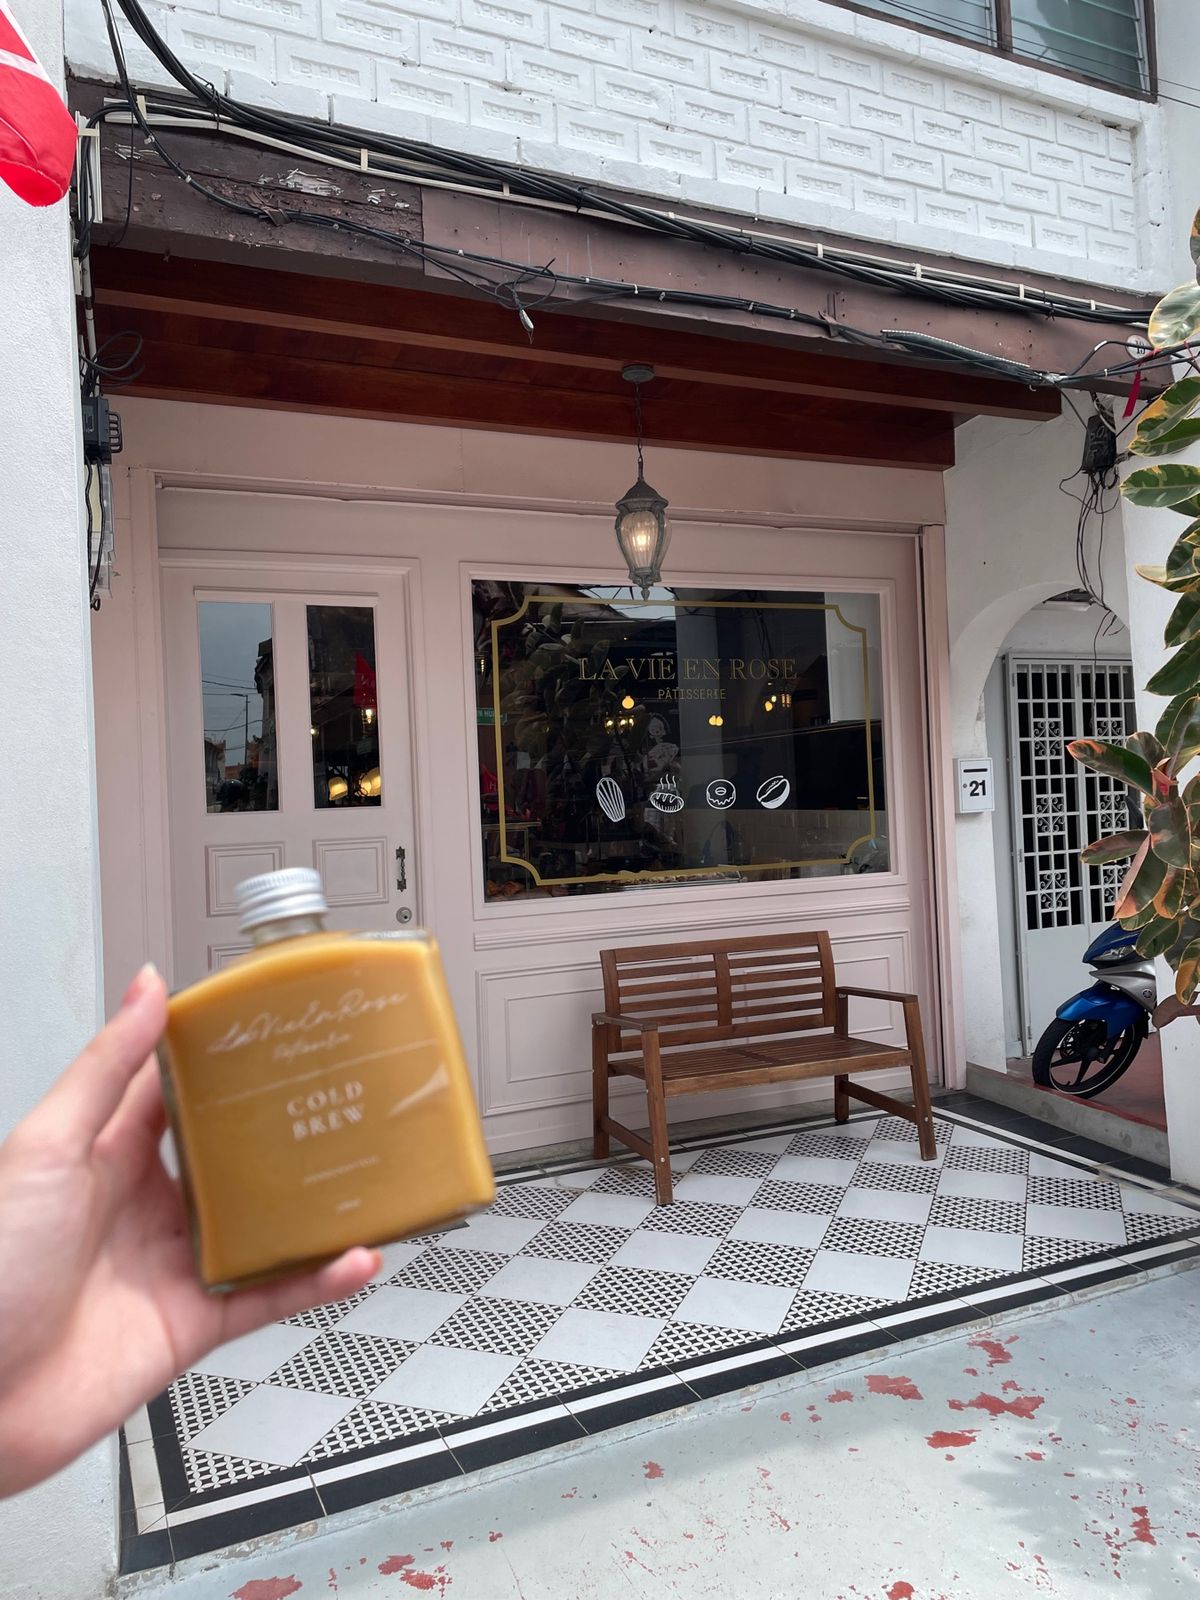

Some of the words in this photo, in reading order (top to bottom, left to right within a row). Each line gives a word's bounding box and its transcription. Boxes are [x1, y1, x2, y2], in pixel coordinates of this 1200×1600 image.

[577, 658, 619, 680] LA
[625, 658, 676, 680] VIE
[683, 658, 720, 680] EN
[729, 658, 799, 680] ROSE
[657, 686, 727, 700] PÂTISSERIE
[969, 780, 986, 797] 21
[286, 1080, 363, 1118] COLD
[292, 1102, 365, 1141] BREW
